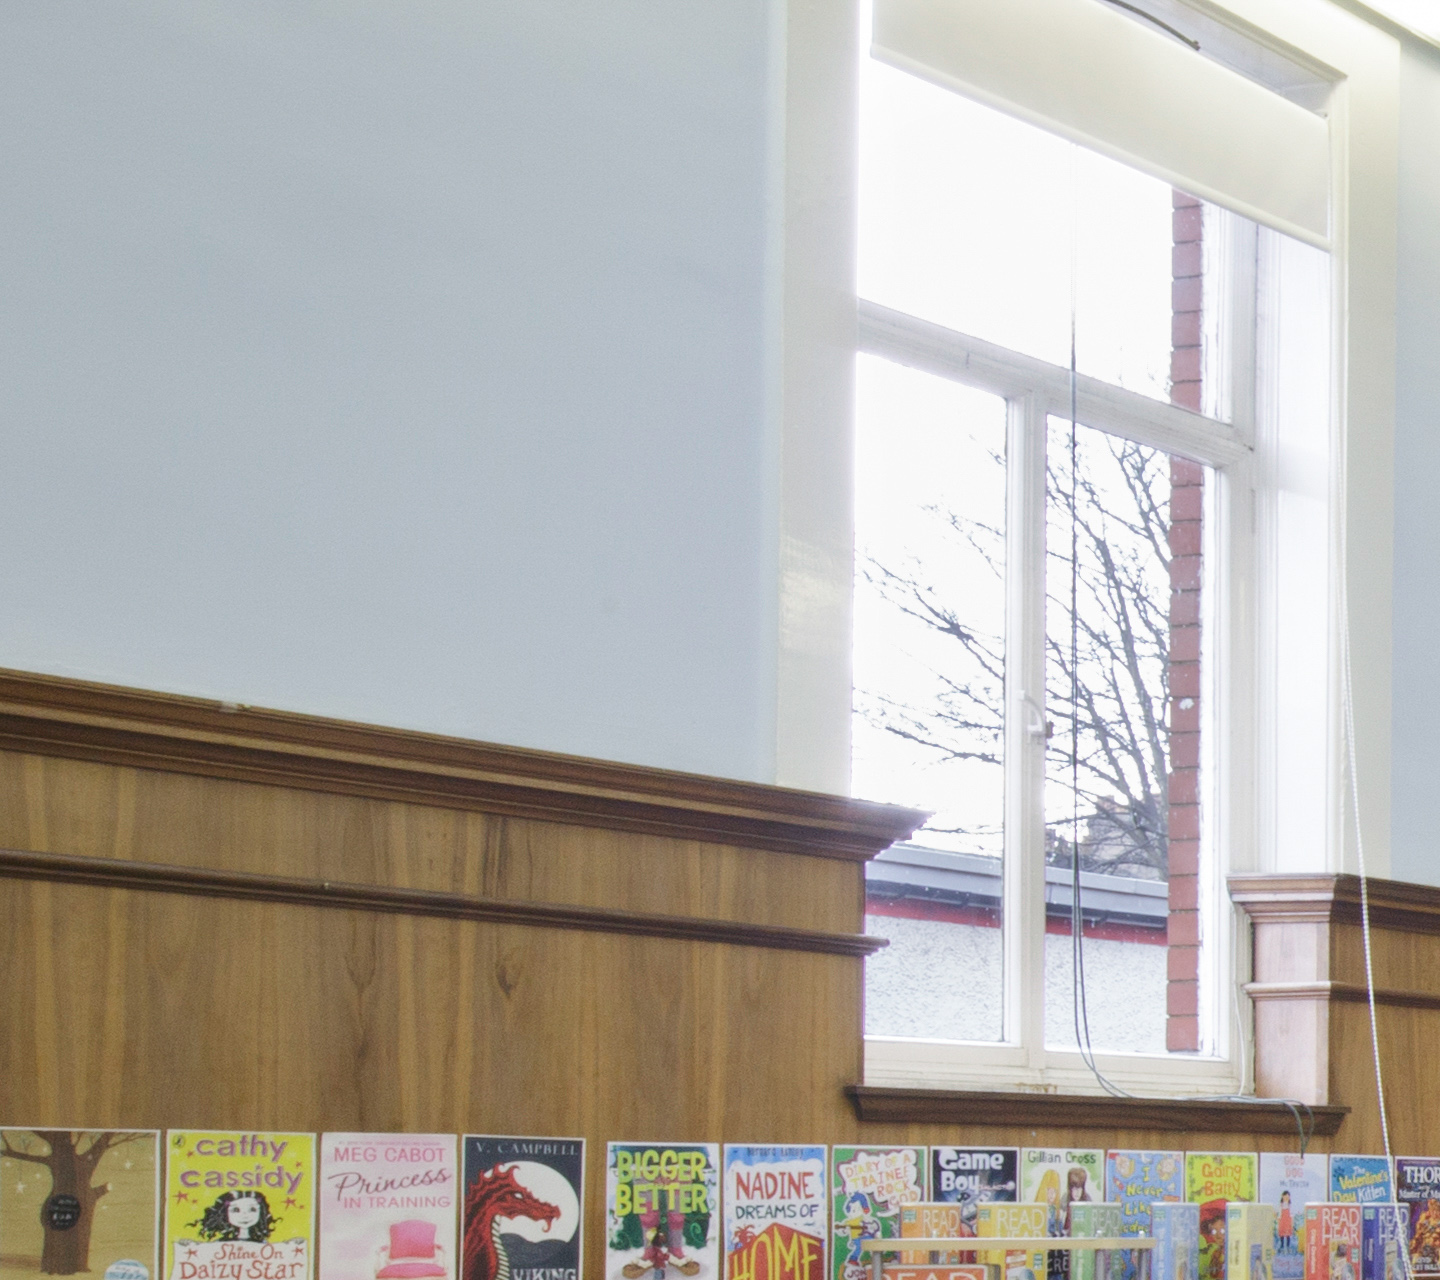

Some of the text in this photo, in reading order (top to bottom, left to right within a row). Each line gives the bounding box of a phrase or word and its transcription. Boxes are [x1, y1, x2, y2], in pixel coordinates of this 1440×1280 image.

[195, 1135, 289, 1162] cathy
[333, 1146, 446, 1163] MEG CABOT
[476, 1141, 579, 1156] V. CAMPBELL
[1027, 1150, 1097, 1165] Gillian Cross
[615, 1149, 707, 1183] BIGGER
[939, 1150, 1004, 1171] Game
[180, 1166, 303, 1194] cassidy
[1201, 1162, 1242, 1180] Going
[327, 1167, 451, 1202] Princess
[735, 1172, 815, 1201] NADINE
[876, 1180, 910, 1198] ROCK
[940, 1172, 980, 1195] Boy
[1125, 1183, 1164, 1199] Never
[1203, 1180, 1240, 1198] Batty
[343, 1195, 451, 1209] IN TRAINING
[614, 1182, 710, 1217] BETTER
[1357, 1185, 1387, 1203] Kitten
[735, 1204, 820, 1220] DREAMS OF
[1322, 1207, 1359, 1226] READ
[1322, 1226, 1359, 1244] HEAR
[214, 1242, 284, 1261] Shine On
[249, 1260, 304, 1280] Star
